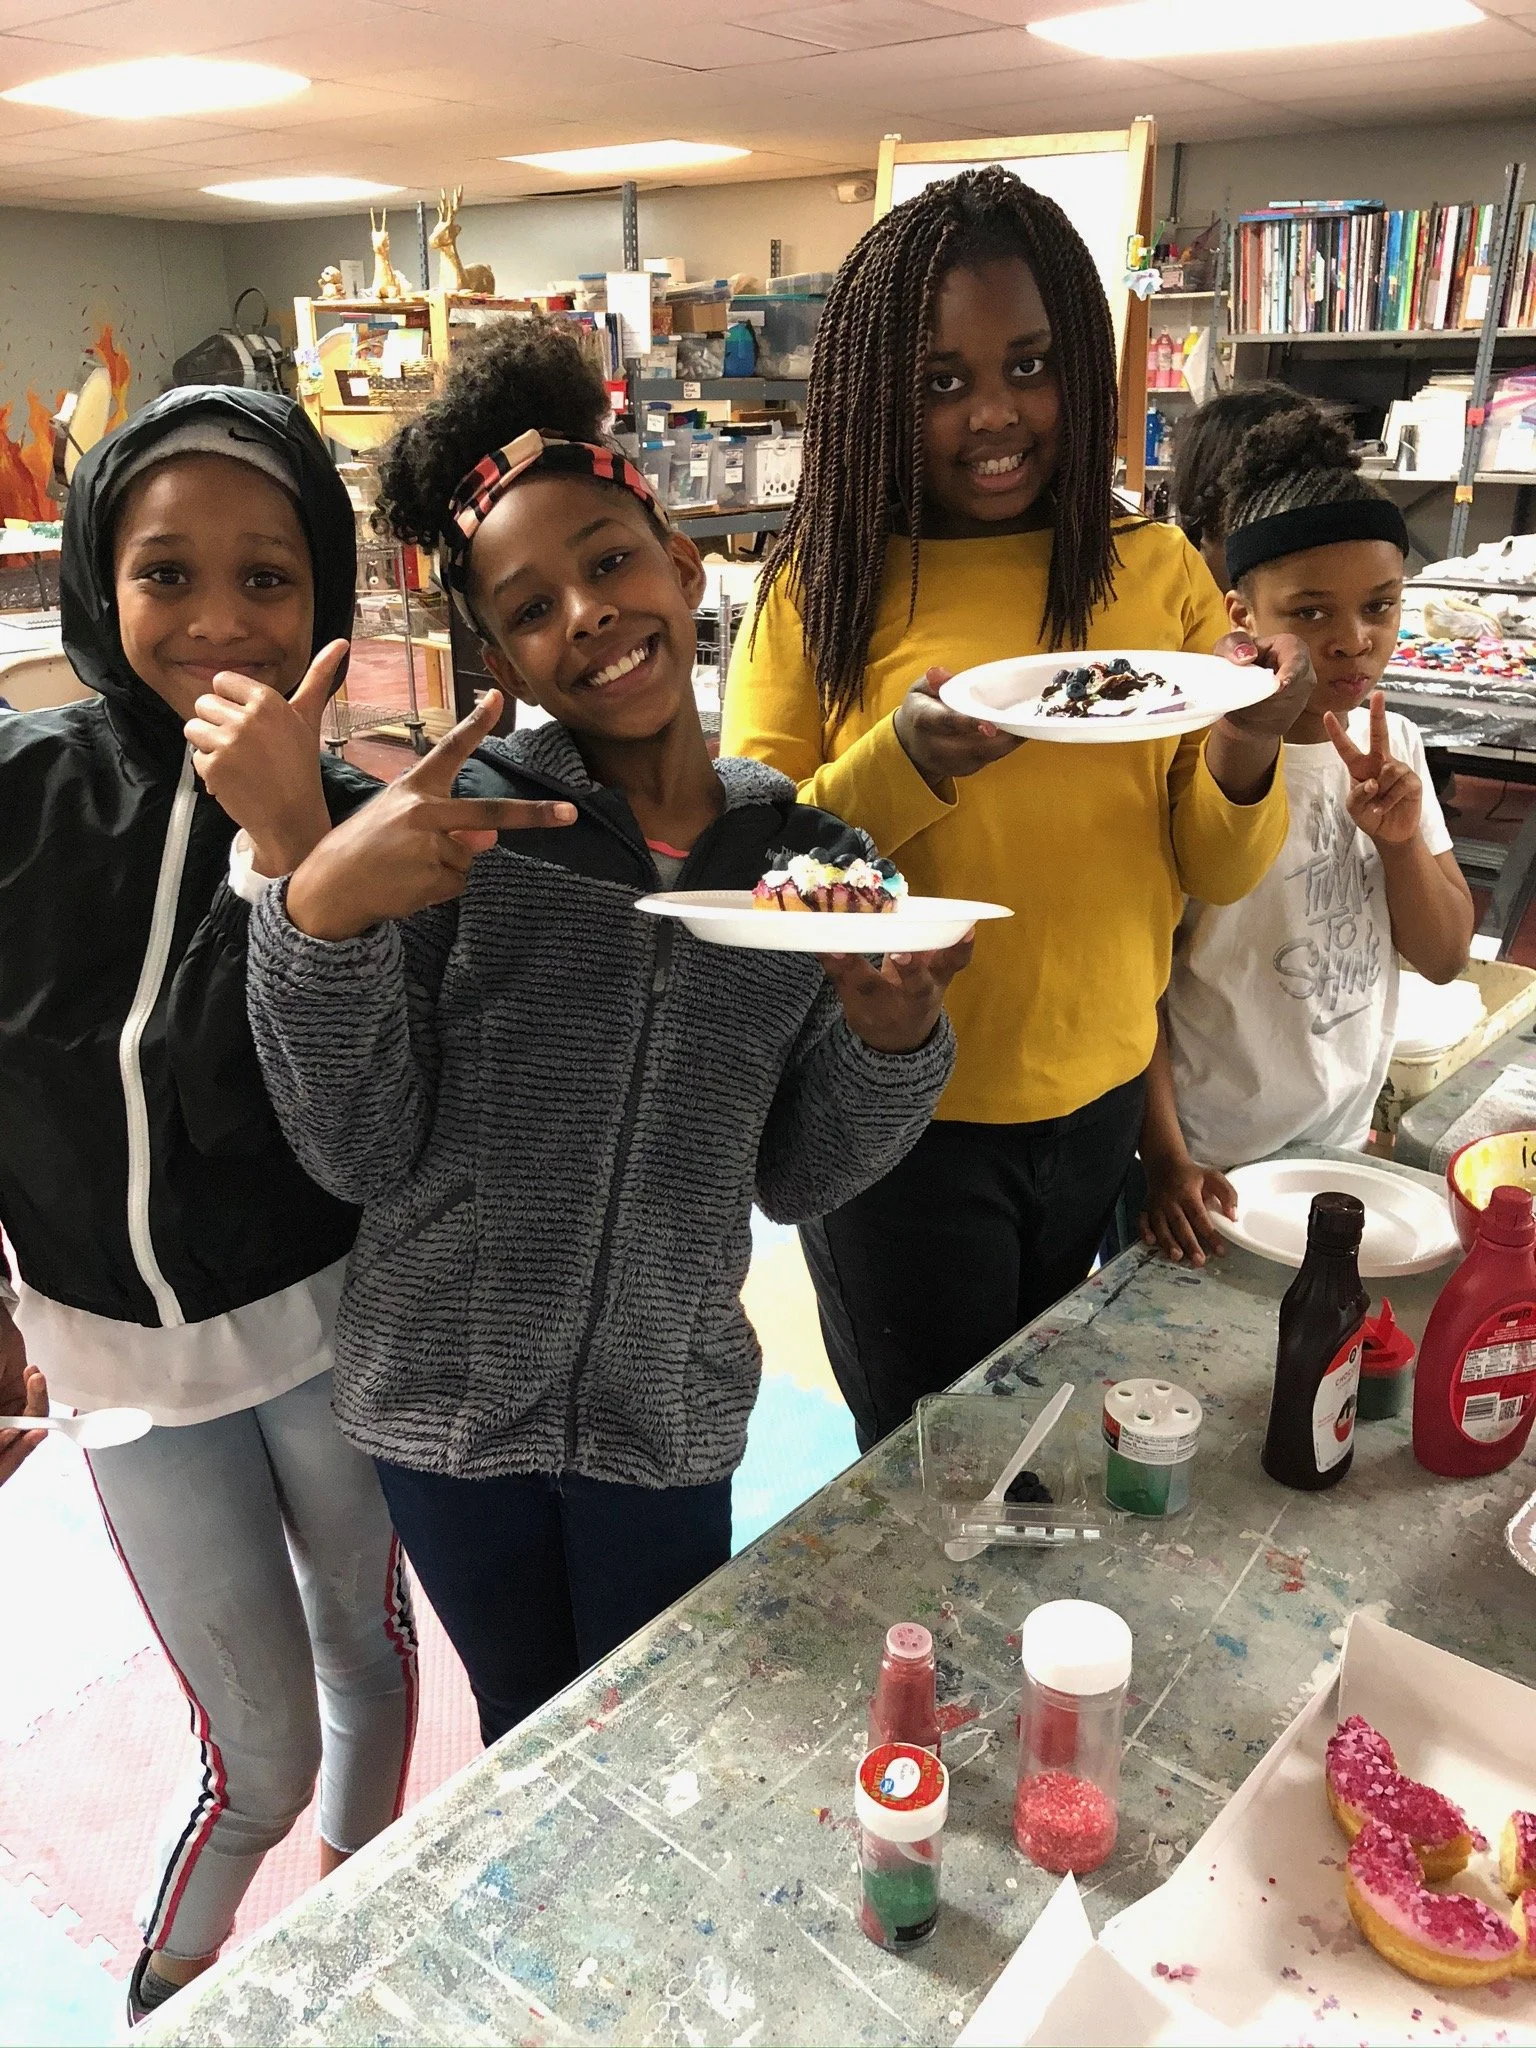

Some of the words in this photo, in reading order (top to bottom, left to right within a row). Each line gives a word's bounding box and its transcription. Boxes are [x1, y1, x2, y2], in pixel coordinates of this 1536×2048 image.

[1284, 852, 1374, 916] TIME
[1307, 905, 1357, 952] TO
[1272, 918, 1382, 1011] SHINE
